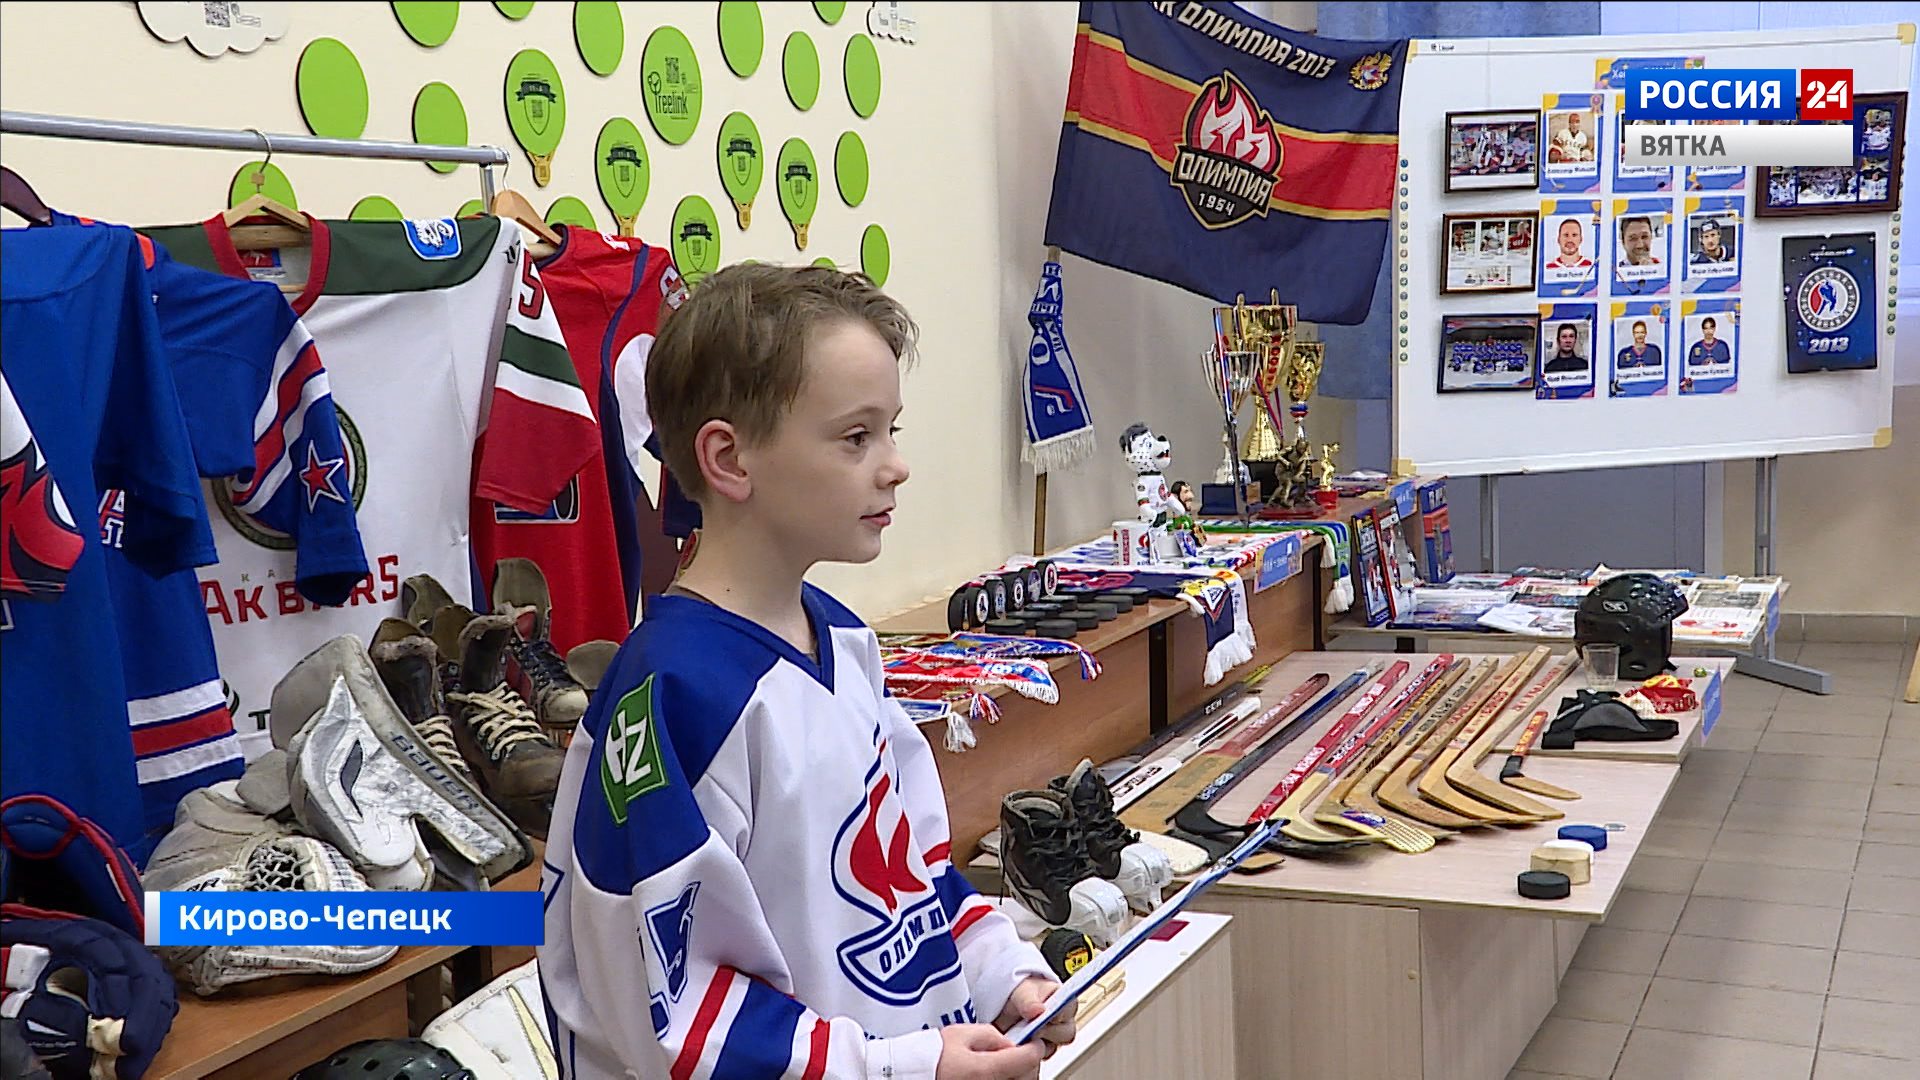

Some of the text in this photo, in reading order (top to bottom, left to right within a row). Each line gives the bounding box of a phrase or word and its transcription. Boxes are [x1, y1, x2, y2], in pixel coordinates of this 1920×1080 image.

[1177, 2, 1293, 66] ОЛИМПИЯ
[1286, 47, 1337, 79] 2013
[1178, 152, 1273, 206] ОЛИМПИЯ
[1807, 336, 1849, 353] 2013
[879, 905, 946, 974] ОЛИМП
